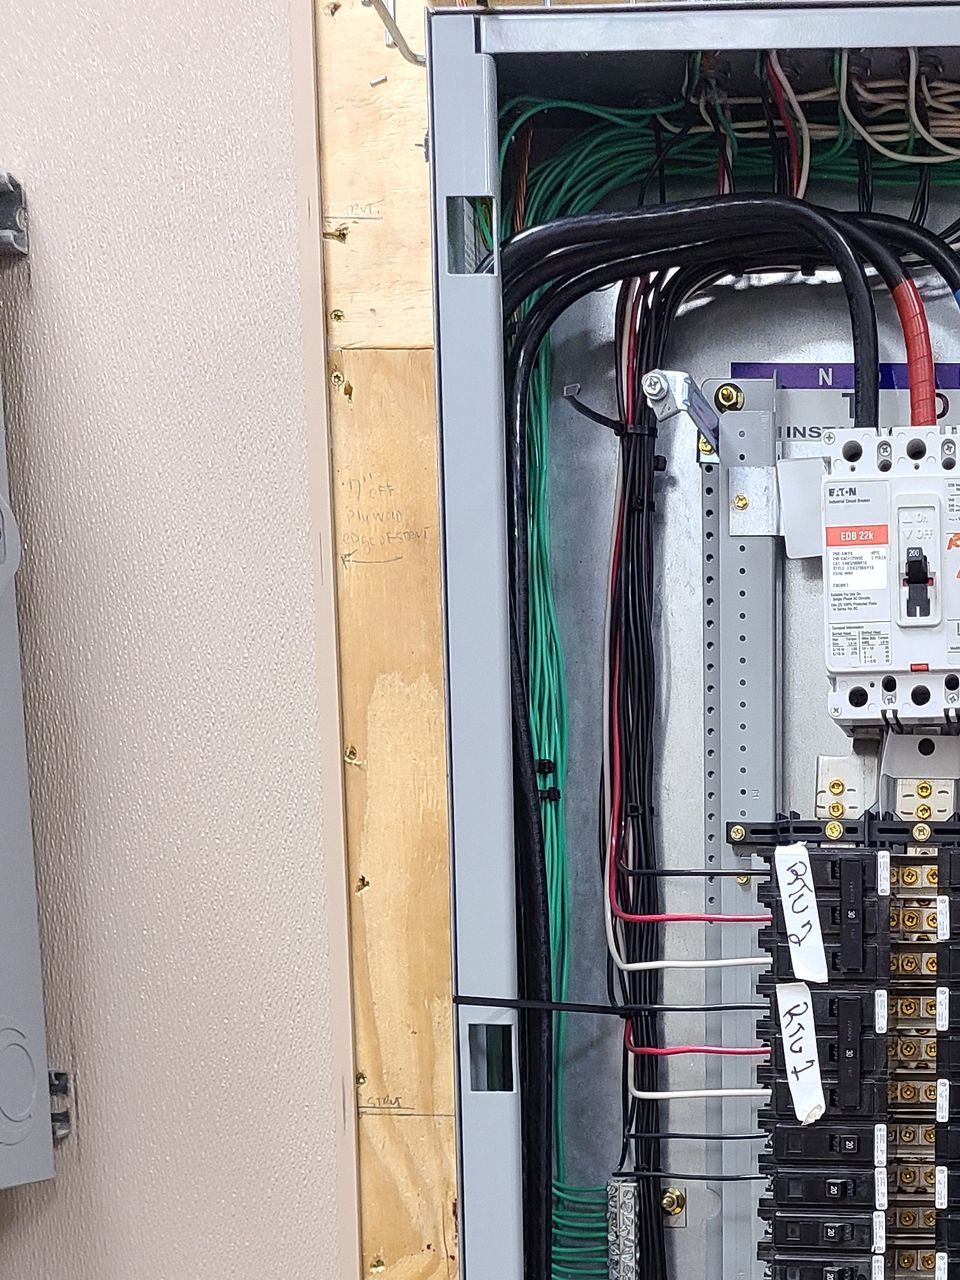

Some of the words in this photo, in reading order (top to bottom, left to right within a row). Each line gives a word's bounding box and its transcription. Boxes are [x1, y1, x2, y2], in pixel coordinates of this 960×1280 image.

[840, 531, 857, 541] EDB
[859, 530, 874, 540] 22k
[786, 860, 813, 914] RTU
[782, 1002, 808, 1054] RTU
